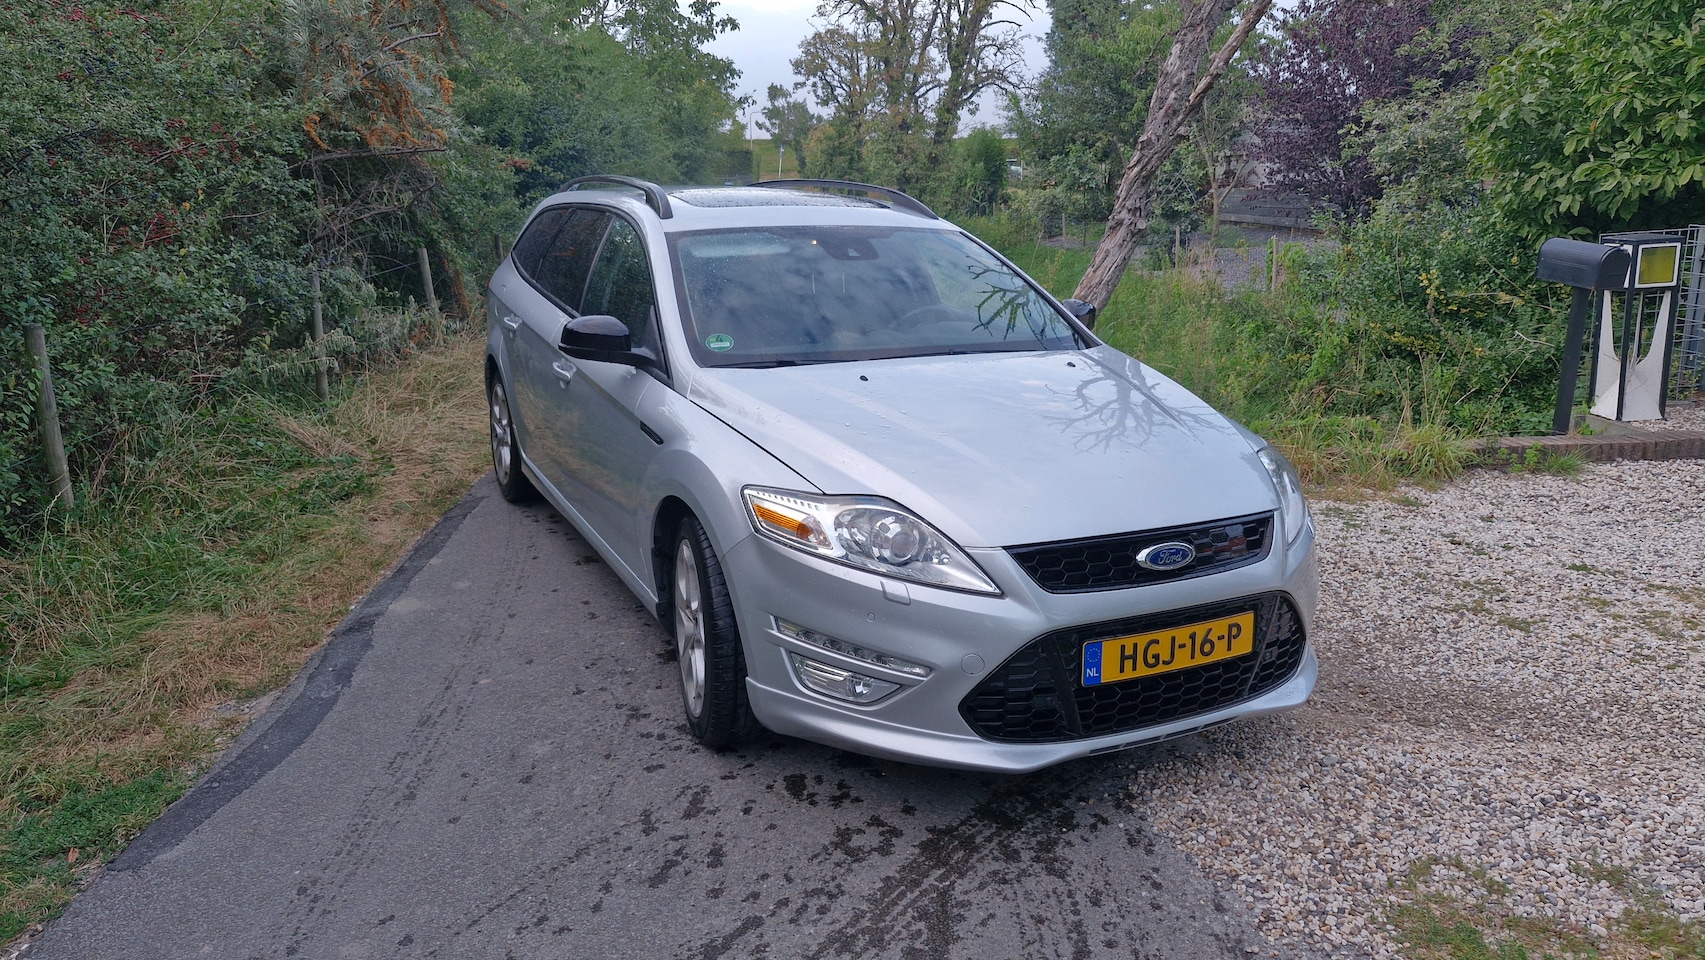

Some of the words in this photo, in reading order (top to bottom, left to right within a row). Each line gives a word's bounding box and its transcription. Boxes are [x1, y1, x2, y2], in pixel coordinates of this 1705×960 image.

[1157, 548, 1183, 565] Ford
[1119, 622, 1242, 673] HGJ-16-P
[1086, 667, 1099, 677] NL
